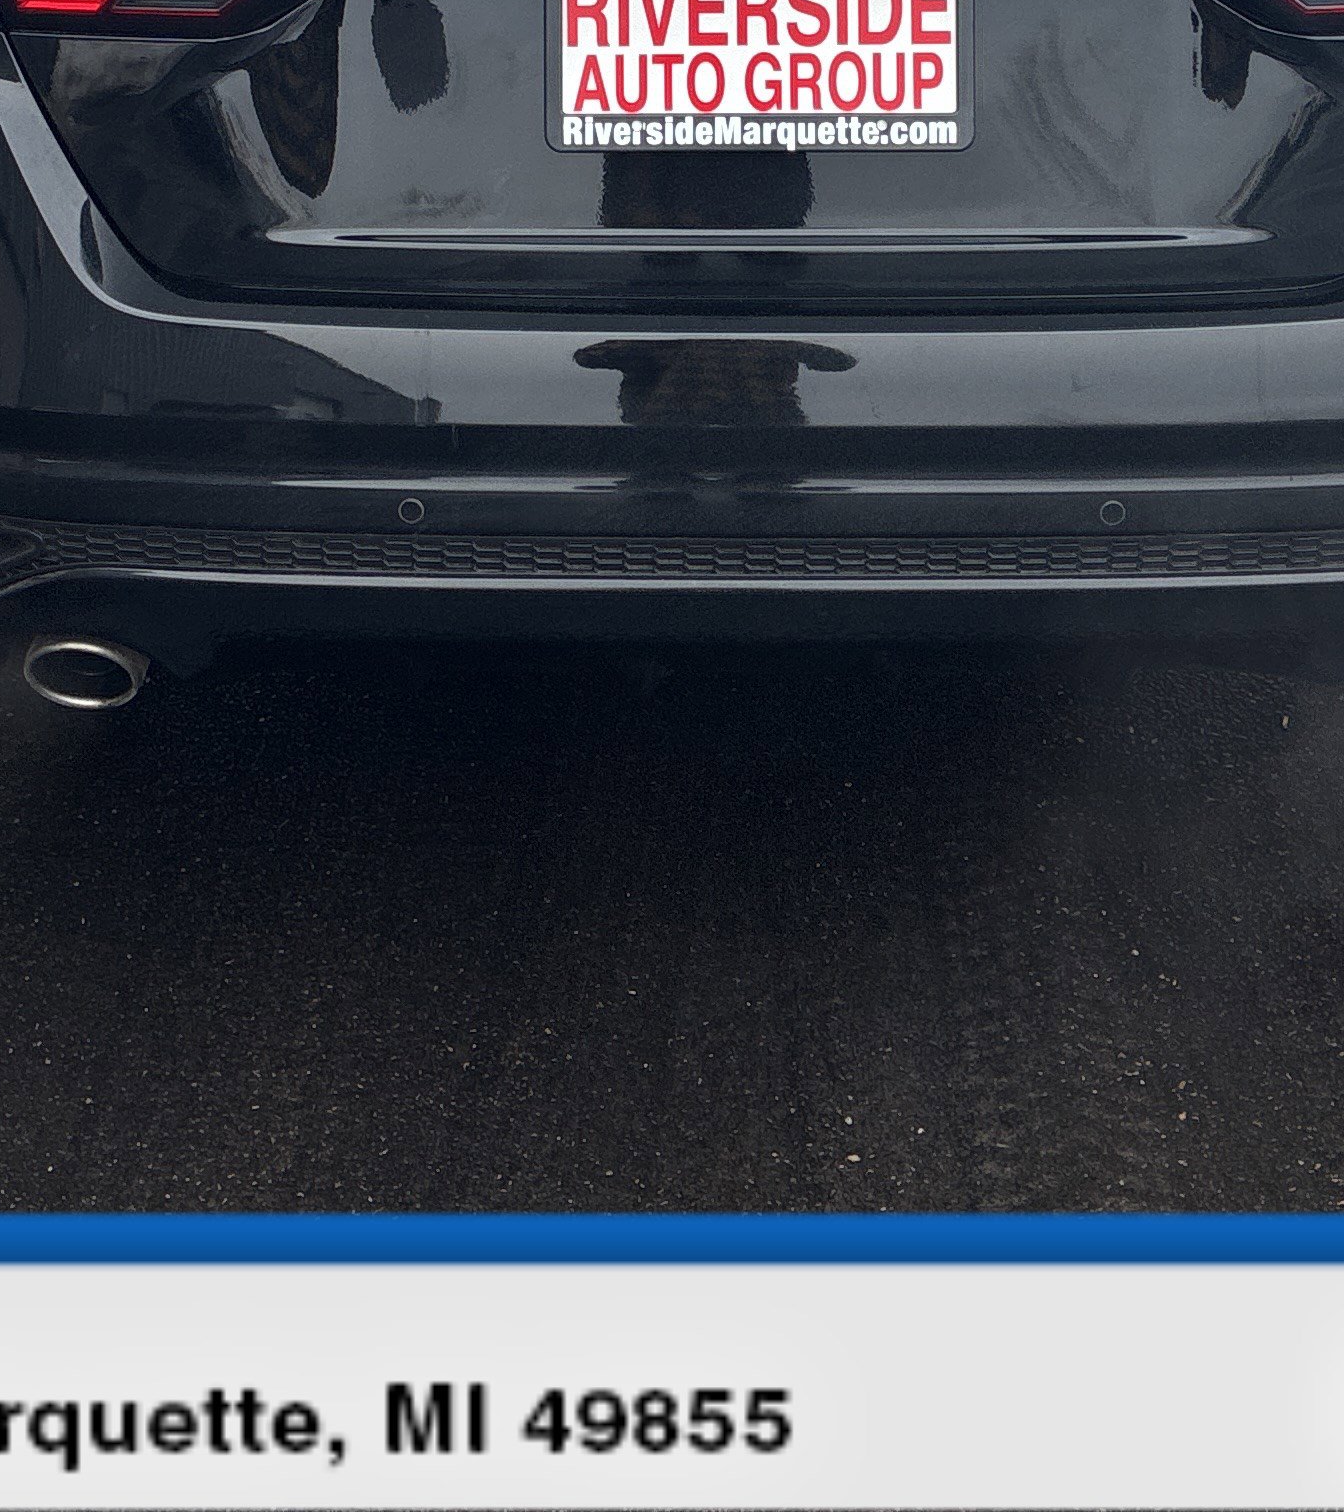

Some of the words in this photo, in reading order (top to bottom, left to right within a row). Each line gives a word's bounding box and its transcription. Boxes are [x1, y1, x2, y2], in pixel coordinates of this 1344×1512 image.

[574, 53, 726, 113] AUTO
[744, 51, 944, 111] GROUP
[562, 115, 957, 151] RiversideMarquette.com
